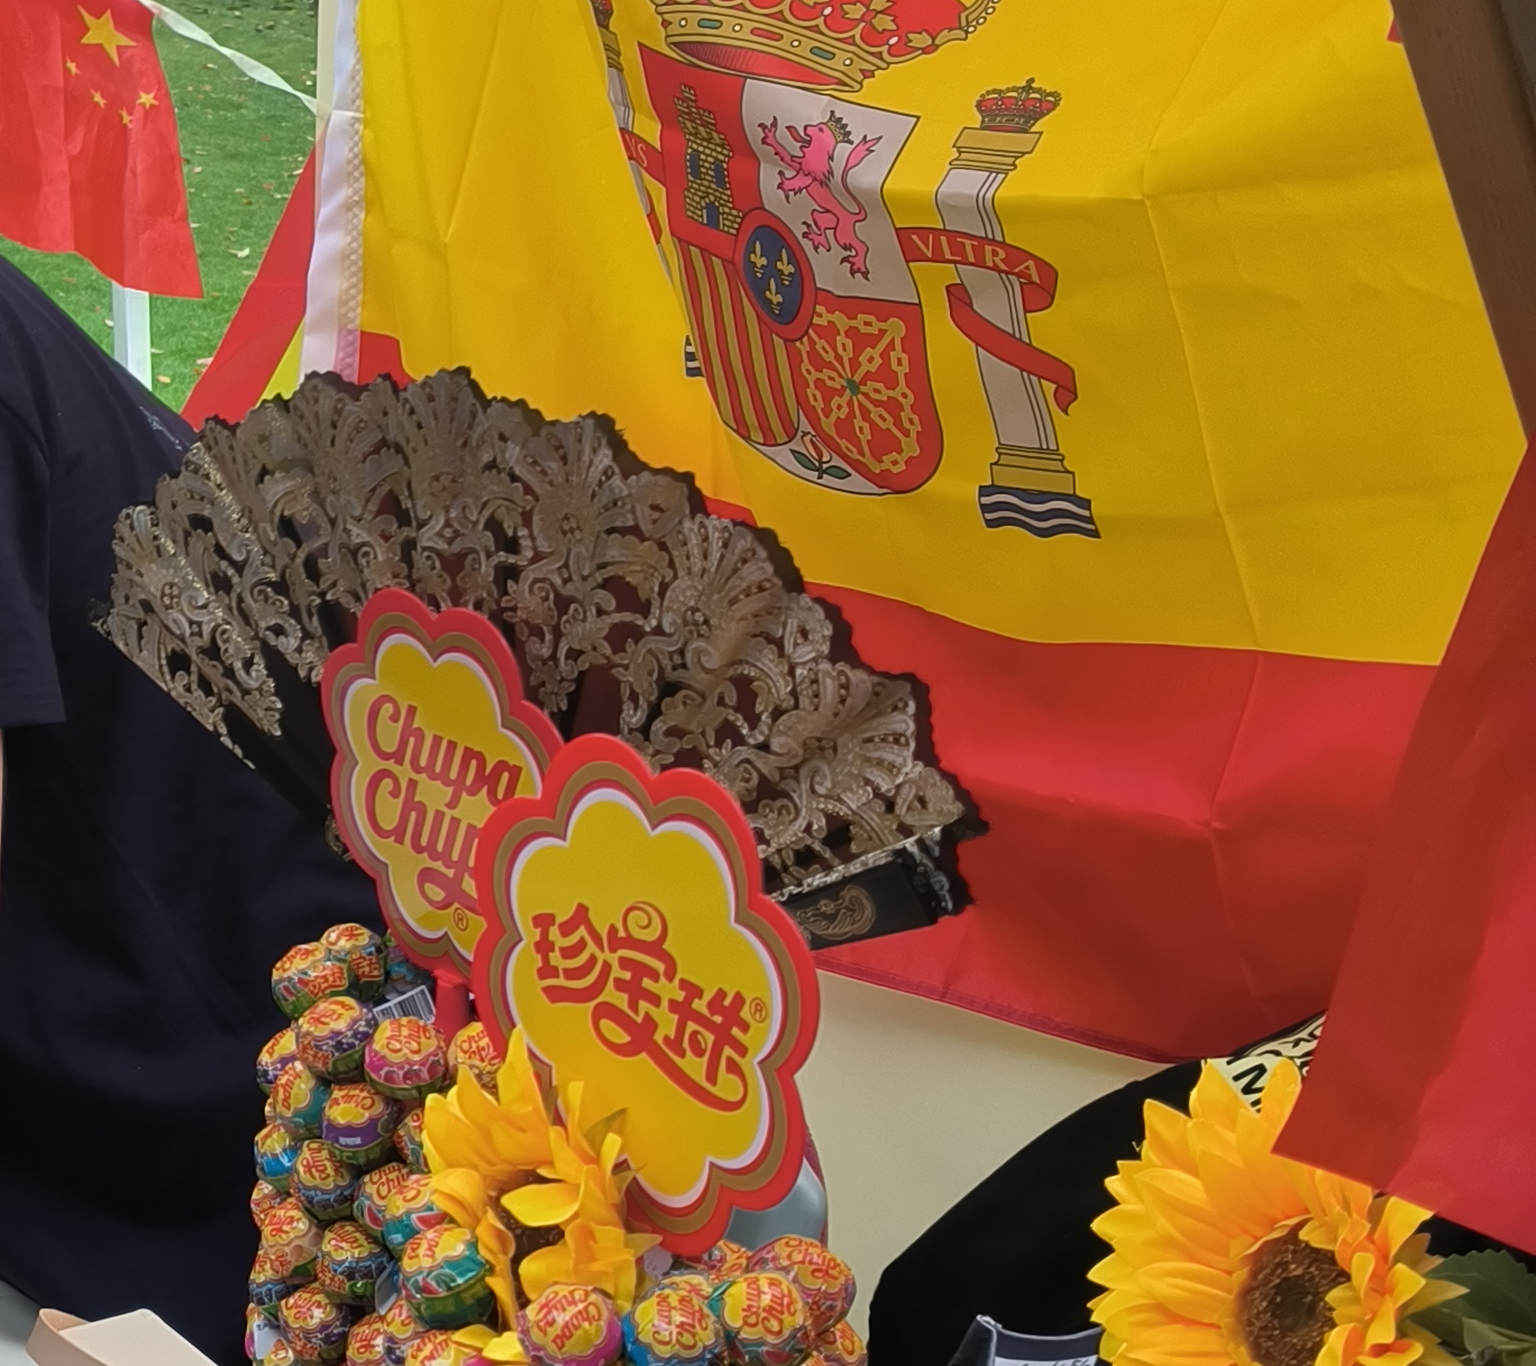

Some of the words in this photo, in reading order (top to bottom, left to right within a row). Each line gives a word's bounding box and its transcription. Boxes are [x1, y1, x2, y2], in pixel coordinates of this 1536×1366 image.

[911, 233, 1041, 285] VLTRA
[366, 693, 524, 811] Chupa
[364, 768, 483, 917] Chup
[531, 900, 751, 1113] 珍宝珠
